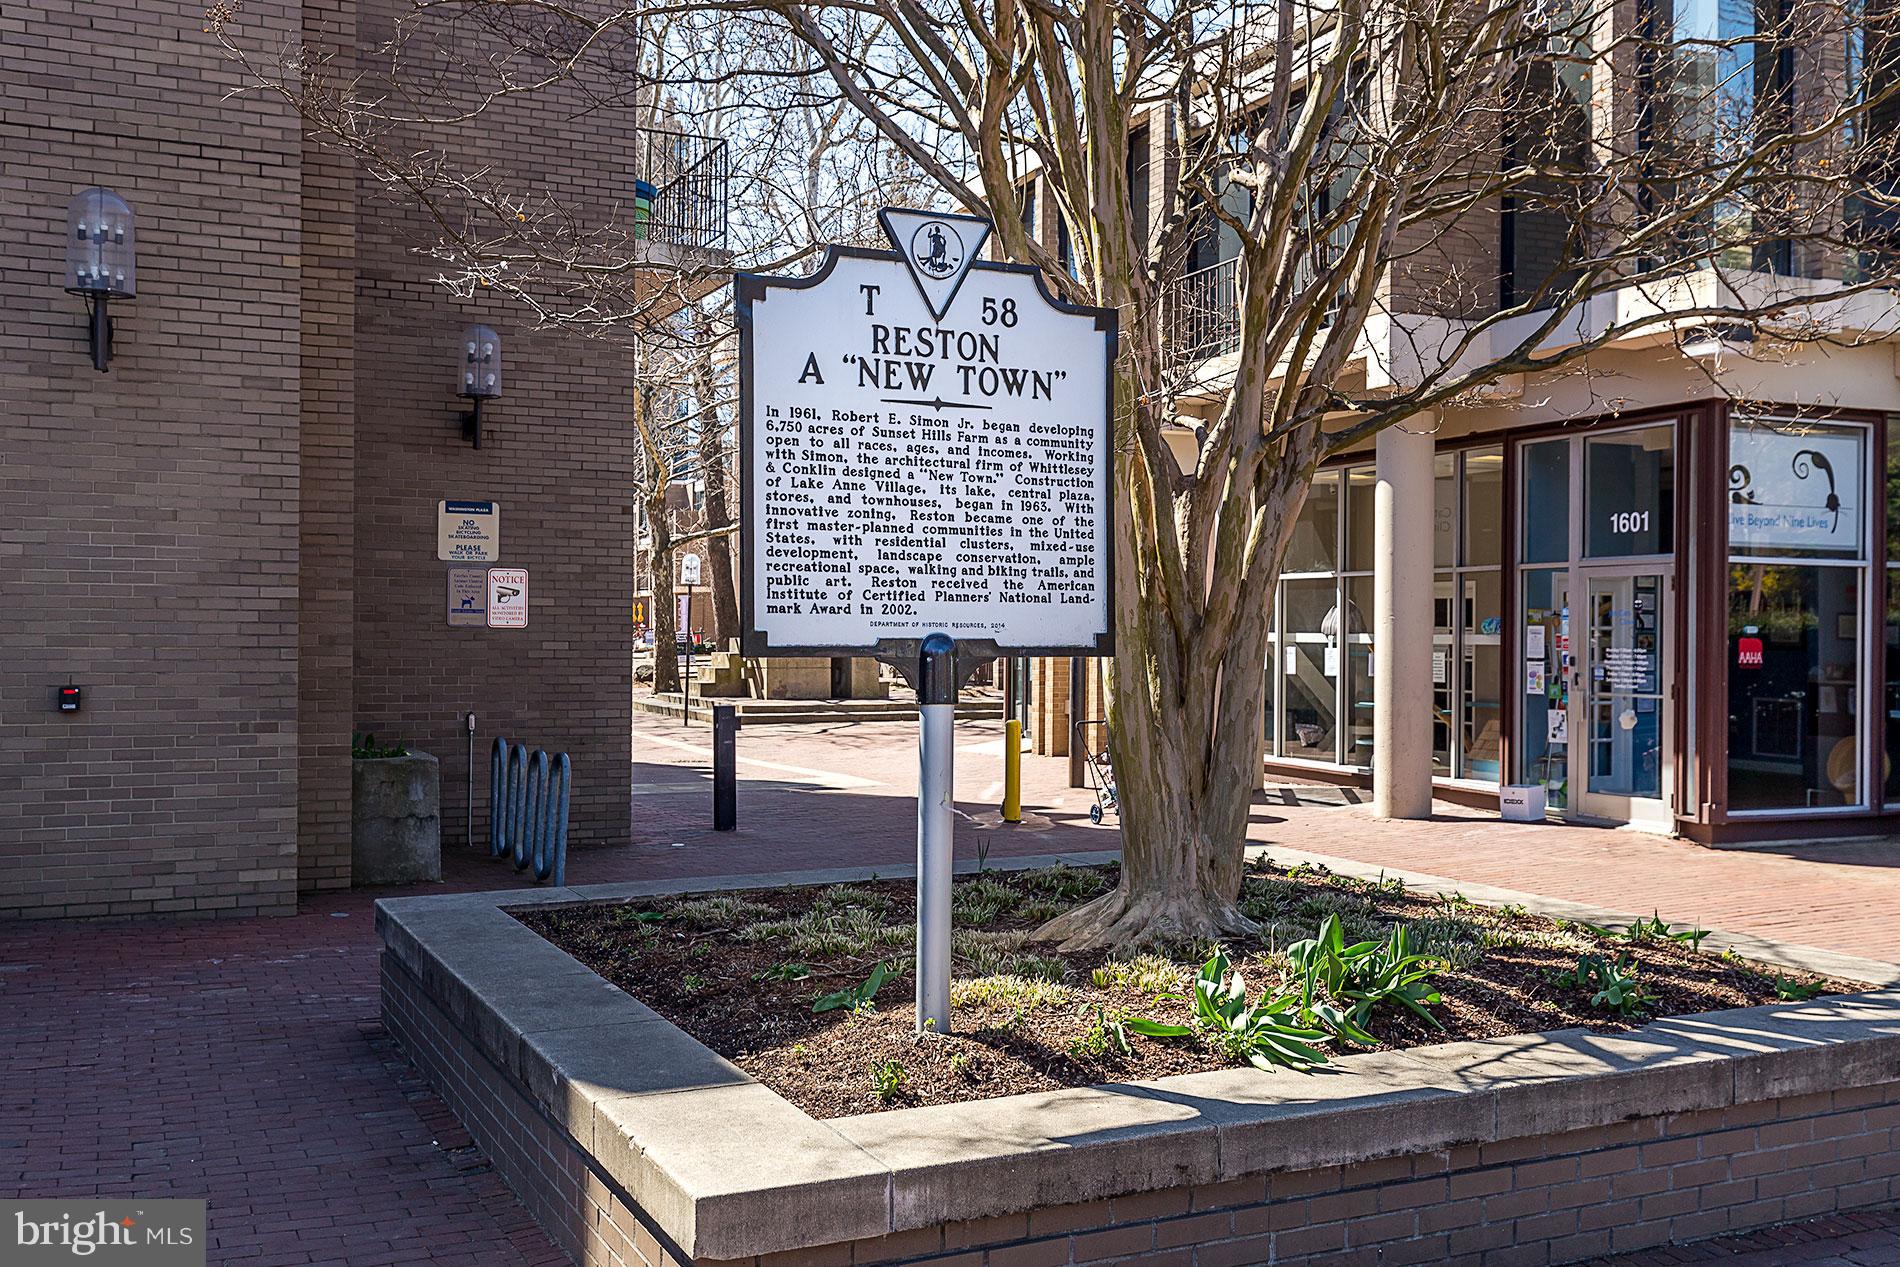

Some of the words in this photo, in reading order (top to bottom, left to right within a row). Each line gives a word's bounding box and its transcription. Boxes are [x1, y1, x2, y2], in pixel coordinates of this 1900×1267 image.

[860, 284, 880, 315] T
[981, 297, 1018, 328] 58
[872, 324, 999, 364] RESTON
[798, 351, 824, 384] A
[766, 406, 779, 417] In
[790, 407, 821, 421] 1961,
[832, 410, 879, 423] Robert
[888, 413, 901, 425] E.
[909, 415, 949, 428] Simon
[957, 417, 974, 429] Jr.
[982, 419, 1020, 434] began
[1029, 422, 1094, 439] developing
[766, 420, 802, 433] 6,750
[808, 426, 843, 435] acres
[850, 425, 865, 436] of
[872, 426, 916, 439] Sunset
[921, 429, 951, 441] Hills
[957, 431, 988, 444] Farm
[995, 436, 1008, 445] as
[1014, 437, 1021, 446] a
[1026, 437, 1094, 451] community
[766, 437, 799, 448] open
[809, 436, 824, 448] to
[833, 438, 849, 449] all
[858, 442, 897, 452] races,
[906, 444, 939, 455] ages,
[948, 445, 970, 456] and
[978, 446, 1032, 459] incomes.
[1045, 449, 1094, 465] Working
[765, 448, 796, 460] with
[801, 450, 848, 464] Simon,
[856, 453, 879, 464] the
[885, 455, 970, 469] architectural
[975, 459, 1003, 471] firm
[1009, 461, 1023, 472] of
[1029, 461, 1094, 477] Whittlesey
[765, 462, 776, 473] &
[783, 463, 836, 476] Conklin
[842, 465, 900, 481] designed
[907, 471, 914, 480] a
[1015, 474, 1094, 488] Construction
[766, 476, 782, 487] of
[791, 477, 824, 489] Lake
[832, 479, 866, 491] Anne
[876, 480, 926, 496] Village,
[940, 484, 957, 495] its
[966, 484, 995, 498] lake,
[1008, 488, 1051, 499] central
[1059, 489, 1095, 502] plaza,
[766, 490, 814, 504] stores,
[827, 493, 851, 504] and
[861, 494, 941, 509] townhouses,
[955, 497, 993, 512] began
[1001, 499, 1013, 511] in
[1021, 500, 1051, 512] 1963.
[1065, 502, 1094, 514] With
[766, 504, 839, 517] innovative
[847, 508, 896, 522] zoning,
[910, 509, 955, 522] Reston
[965, 511, 1013, 524] became
[1022, 517, 1043, 525] one
[1052, 515, 1066, 526] of
[1074, 516, 1094, 527] the
[1610, 511, 1649, 533] 1601
[1748, 514, 1780, 528] Beyond
[1784, 514, 1804, 527] Nine
[1807, 515, 1828, 528] Lives
[766, 518, 799, 530] first
[807, 520, 914, 535] master-planned
[922, 525, 1003, 537] communities
[1010, 526, 1022, 537] in
[1029, 527, 1049, 538] the
[1054, 528, 1094, 539] United
[766, 532, 815, 545] States,
[833, 534, 863, 546] with
[875, 536, 946, 548] residential
[960, 538, 1014, 551] clusters,
[1030, 540, 1095, 552] mixed-use
[766, 546, 858, 561] development,
[878, 549, 942, 564] landscape
[956, 553, 1041, 565] conservation,
[1059, 554, 1095, 567] ample
[766, 561, 851, 573] recreational
[858, 565, 899, 576] space,
[908, 563, 957, 578] walking
[961, 565, 984, 576] and
[988, 565, 1027, 579] biking
[1031, 566, 1068, 578] trails,
[1073, 566, 1094, 578] and
[767, 574, 809, 589] public
[825, 575, 851, 587] art.
[871, 576, 917, 588] Reston
[931, 578, 988, 589] received
[1003, 579, 1024, 590] the
[1037, 580, 1095, 591] American
[766, 588, 828, 600] Institute
[838, 590, 853, 600] of
[862, 589, 925, 602] Certified
[999, 591, 1052, 603] National
[1060, 592, 1095, 604] Land-
[766, 602, 802, 614] mark
[809, 602, 852, 615] Award
[860, 603, 873, 615] in
[882, 603, 917, 615] 2002.
[1738, 652, 1763, 663] AAHA
